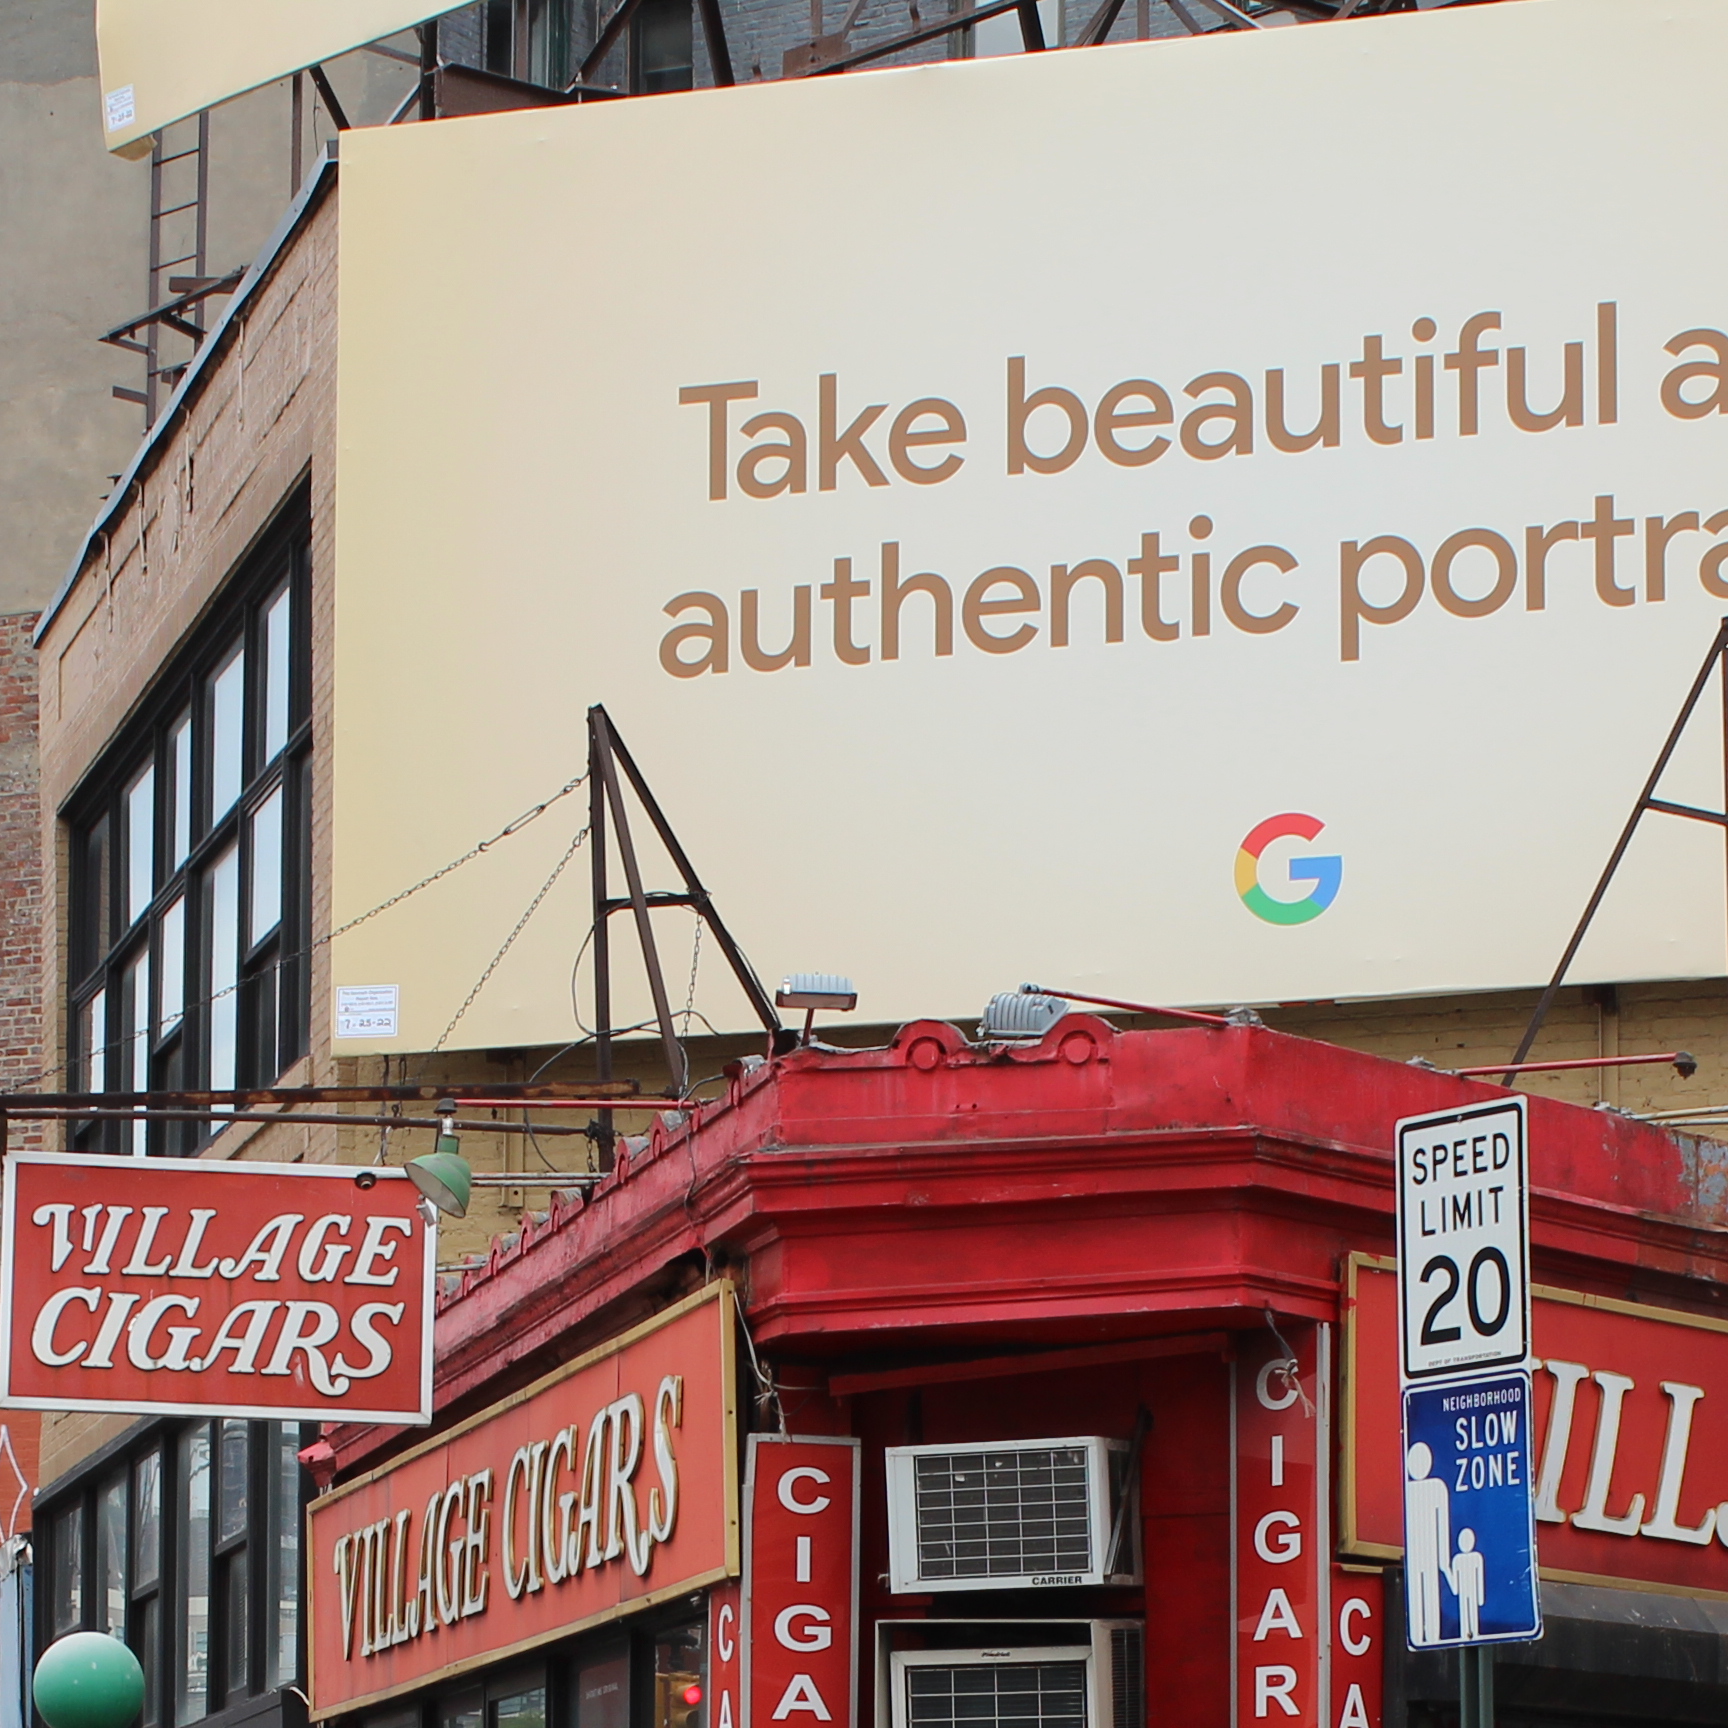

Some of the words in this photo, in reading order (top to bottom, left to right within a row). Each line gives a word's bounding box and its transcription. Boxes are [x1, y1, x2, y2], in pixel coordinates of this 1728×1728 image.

[679, 374, 967, 502] Take
[1006, 300, 1618, 476] beautiful
[658, 514, 1300, 681] authentic
[1412, 1132, 1510, 1186] SPEED
[32, 1203, 412, 1287] VILLAGE
[1421, 1187, 1505, 1237] LIMIT
[1419, 1246, 1511, 1347] 20
[31, 1286, 404, 1396] CIGARS
[1443, 1387, 1521, 1412] NEIGHBORHOOD
[1455, 1410, 1517, 1451] SLOW
[1455, 1450, 1521, 1492] ZONE
[333, 1467, 493, 1661] VILLAGE
[502, 1375, 683, 1600] CIGARS
[1253, 1359, 1303, 1718] CIGAR
[1032, 1575, 1082, 1586] CARRIER
